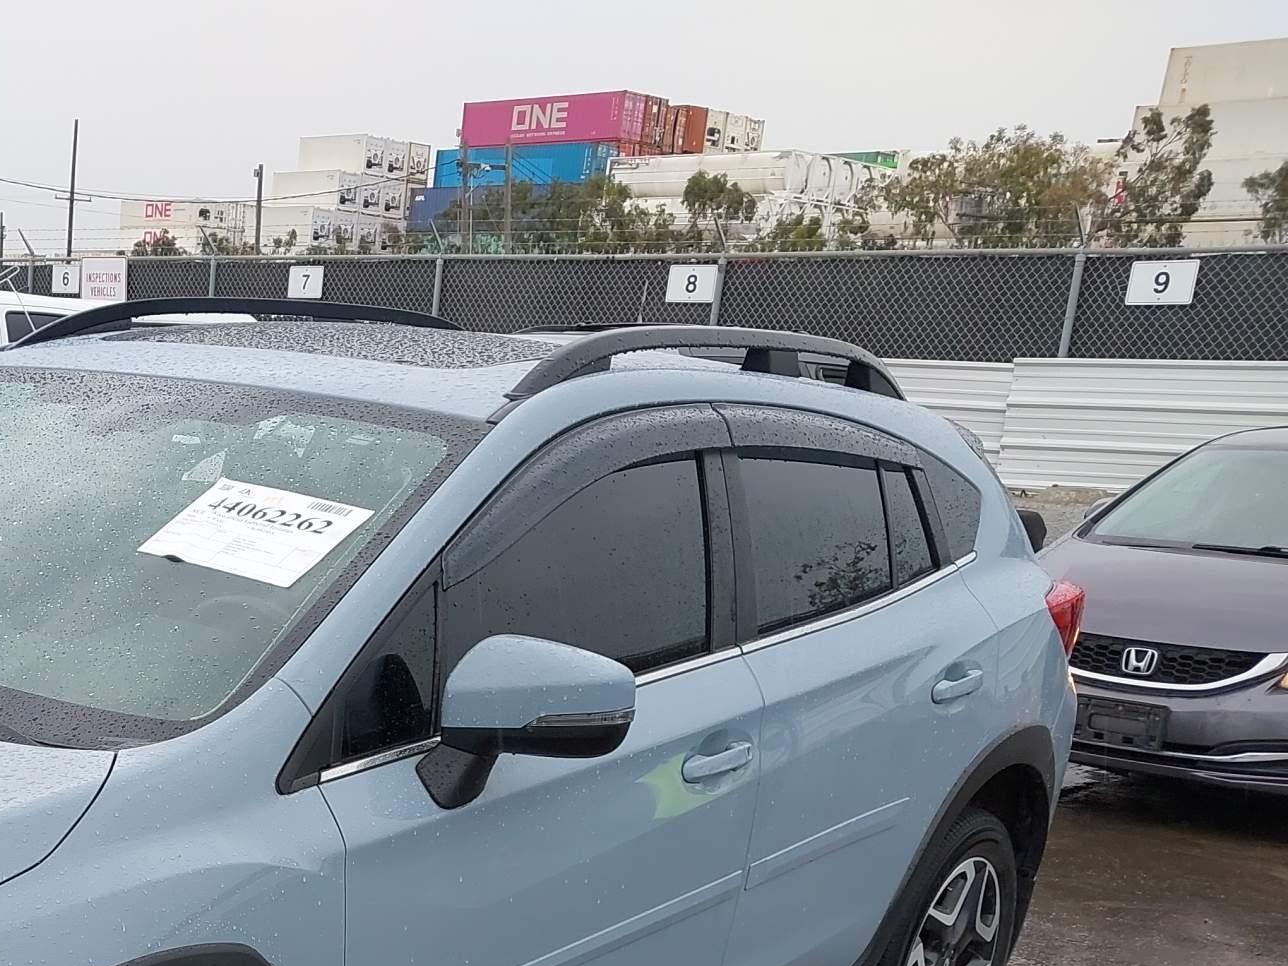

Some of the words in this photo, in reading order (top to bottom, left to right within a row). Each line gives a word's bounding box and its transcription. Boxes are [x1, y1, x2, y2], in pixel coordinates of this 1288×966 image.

[511, 101, 569, 131] ONE
[144, 203, 172, 218] ONE
[62, 271, 70, 286] 6
[86, 272, 121, 283] INSPECTIONS
[302, 274, 311, 290] 7
[685, 274, 698, 294] 8
[1153, 271, 1170, 294] 9
[90, 286, 117, 297] VEHICLES
[208, 497, 334, 534] 44062262
